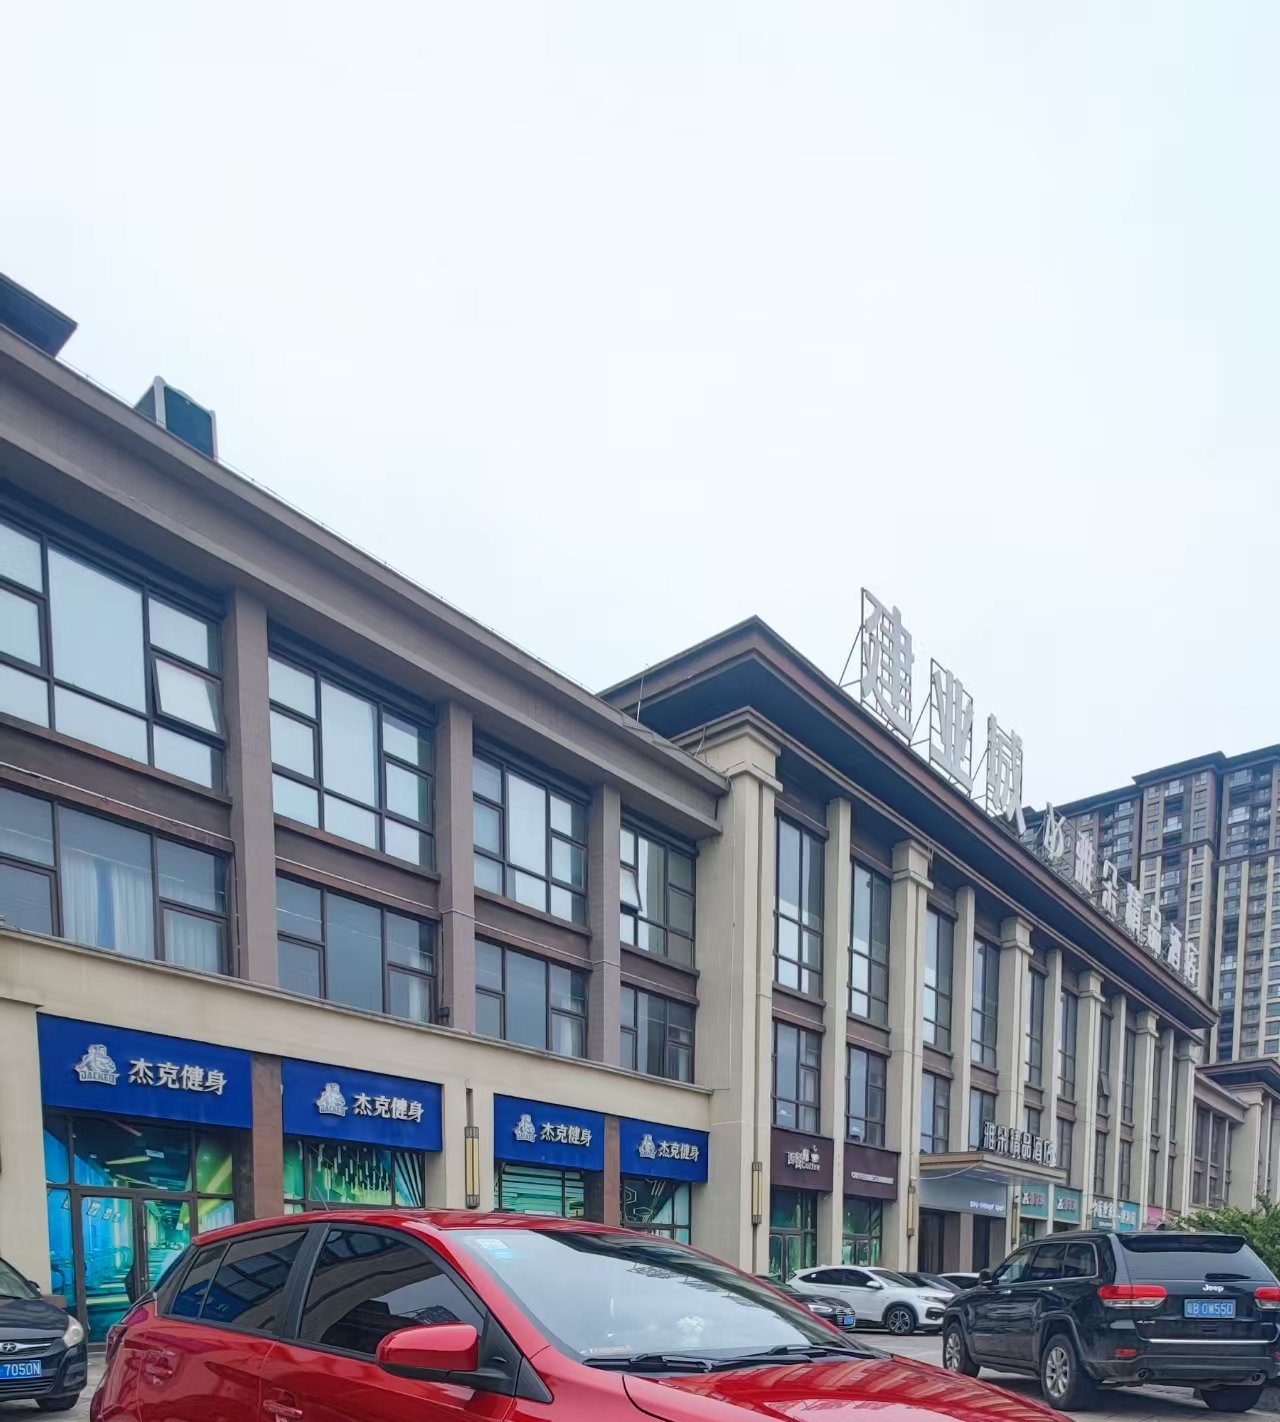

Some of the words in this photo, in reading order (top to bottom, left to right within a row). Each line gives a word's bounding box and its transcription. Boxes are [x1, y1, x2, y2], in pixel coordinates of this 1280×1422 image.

[128, 1058, 227, 1095] 杰克健身
[353, 1092, 424, 1122] 杰克健身
[540, 1122, 592, 1147] 杰克健身
[657, 1140, 699, 1162] 杰克健身
[1202, 1284, 1224, 1293] Jeep
